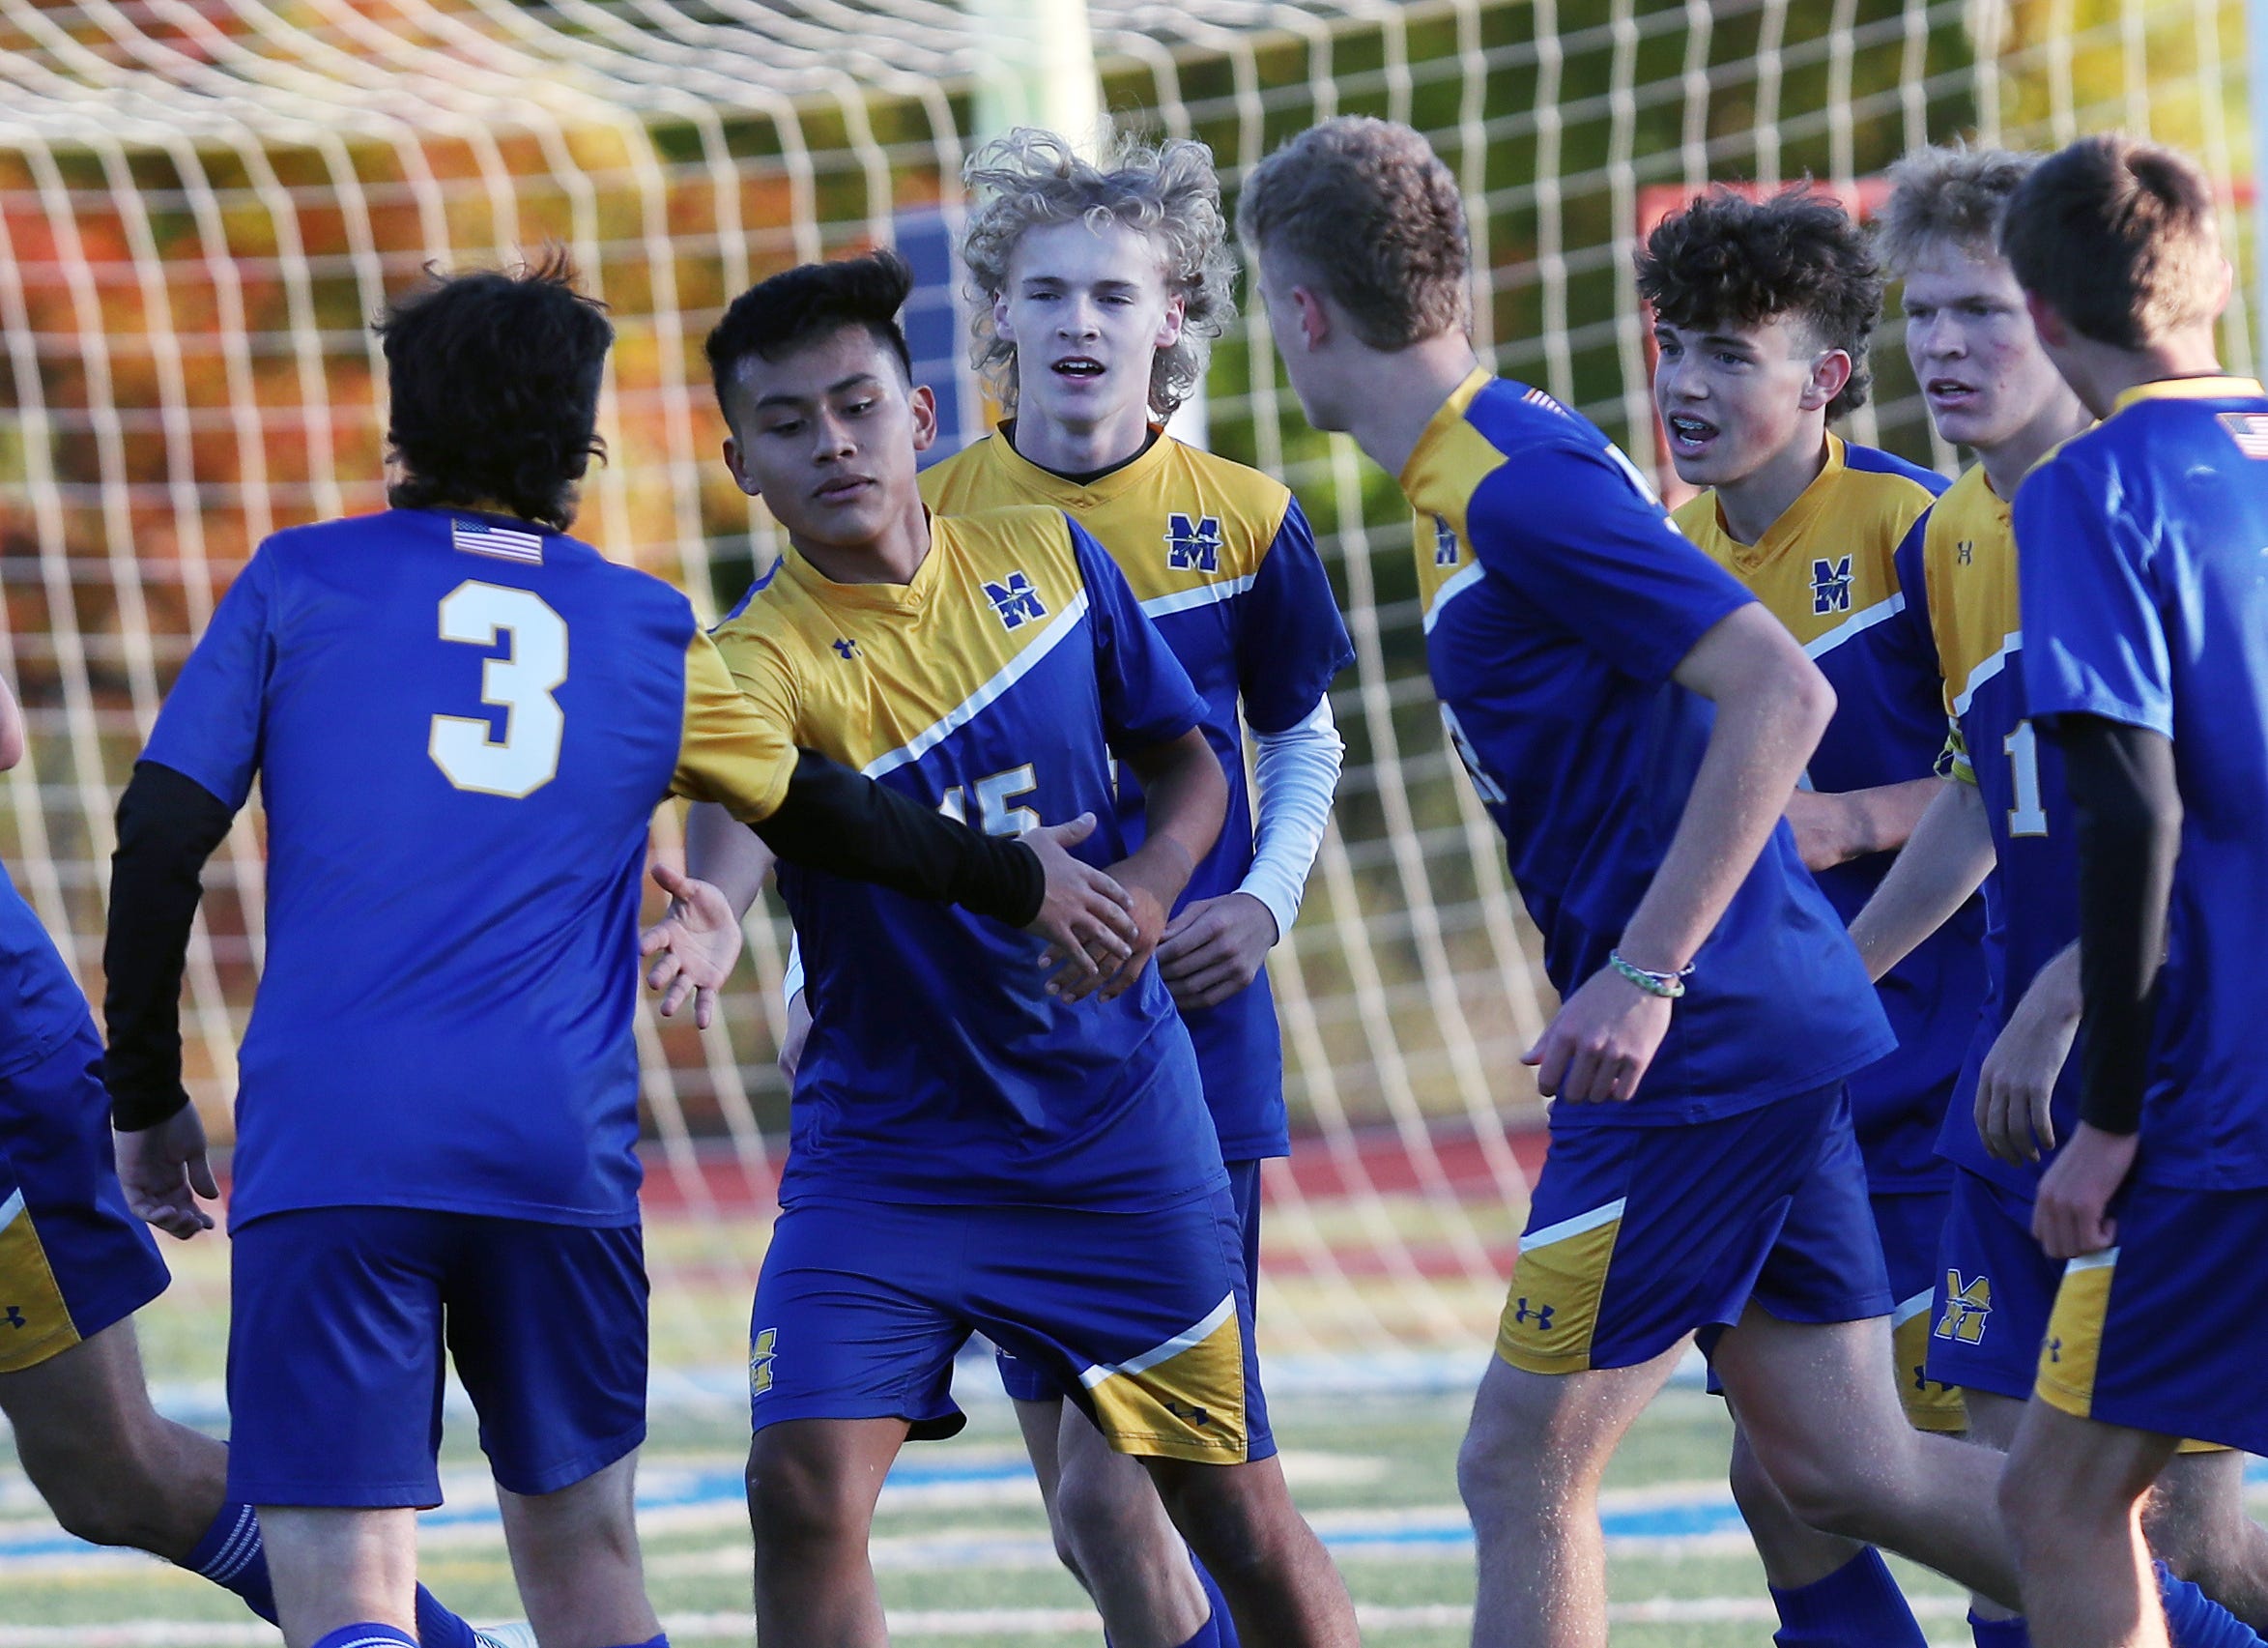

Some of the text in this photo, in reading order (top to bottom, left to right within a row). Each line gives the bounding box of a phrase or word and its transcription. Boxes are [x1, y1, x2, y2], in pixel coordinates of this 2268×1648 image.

[1163, 512, 1222, 574] M
[980, 569, 1050, 632] M
[1810, 554, 1855, 616] M
[427, 578, 570, 800] 3
[2003, 719, 2049, 837] 1
